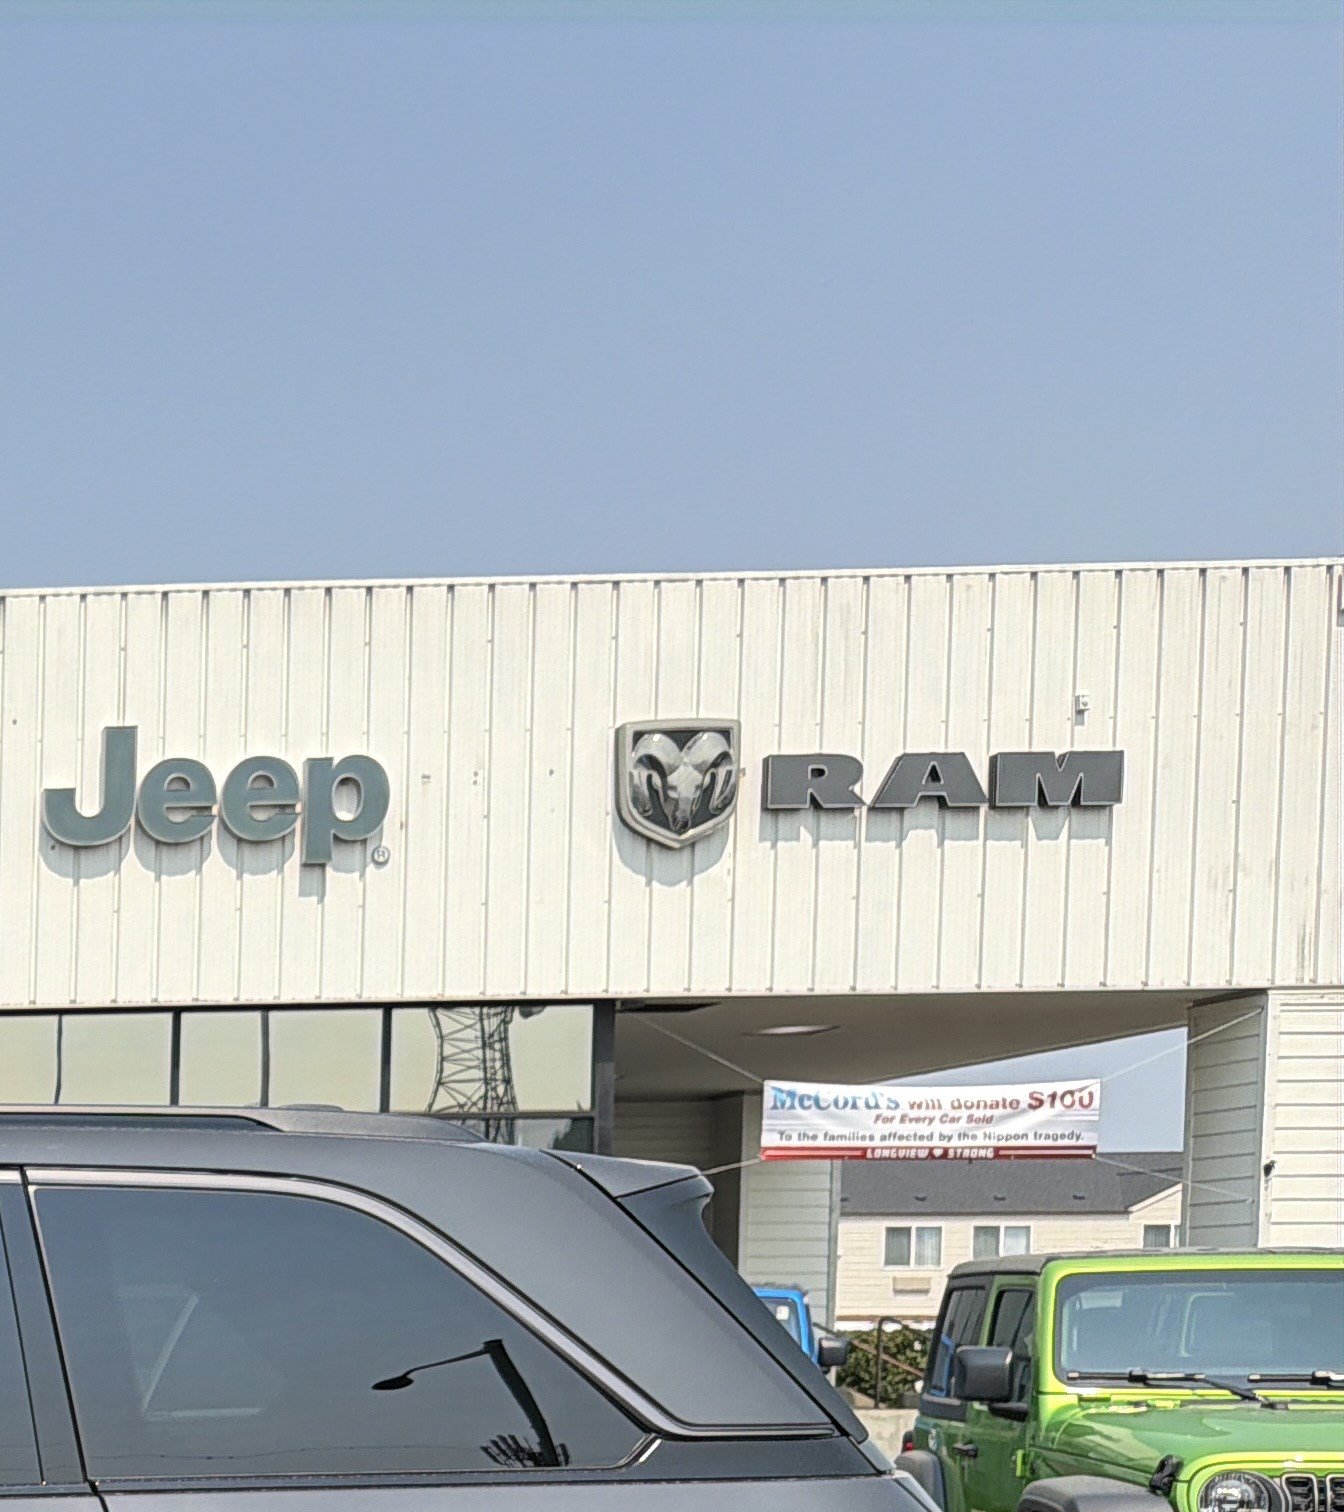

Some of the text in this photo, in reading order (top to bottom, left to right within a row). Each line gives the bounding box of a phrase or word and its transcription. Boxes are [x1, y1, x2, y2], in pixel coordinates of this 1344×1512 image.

[763, 749, 1124, 809] RAM
[41, 725, 388, 864] Jeep
[770, 1086, 900, 1110] McCord's
[908, 1097, 942, 1110] will
[950, 1097, 1020, 1110] donate
[873, 1113, 994, 1126] For Every Car Sold
[777, 1130, 1084, 1142] To the families affected by the Nippon tragedy.
[866, 1148, 994, 1158] LONGVIEW STRONG
